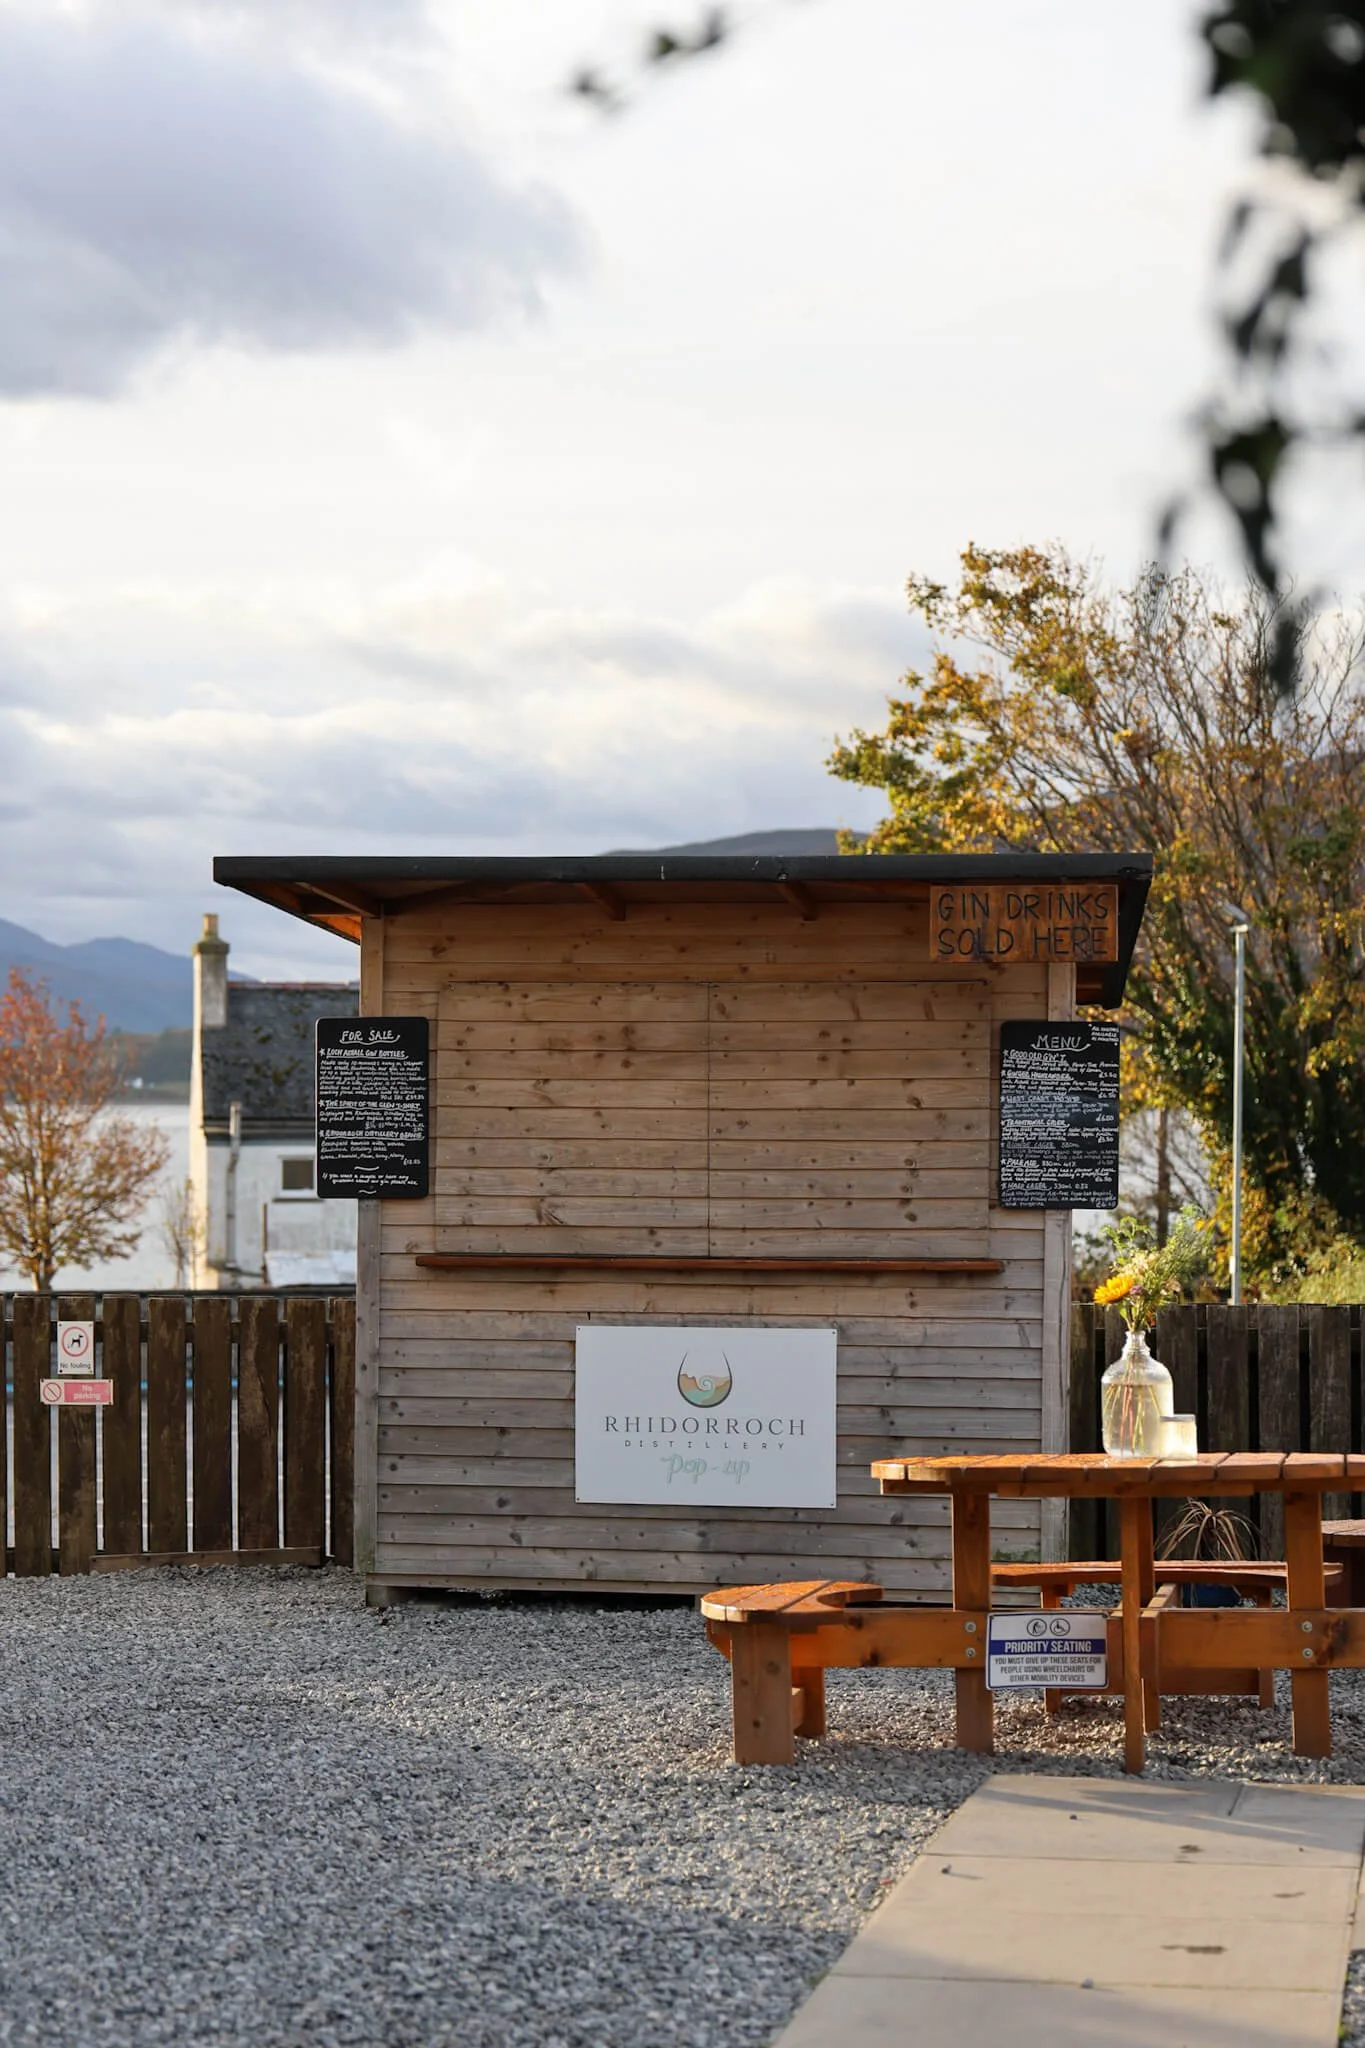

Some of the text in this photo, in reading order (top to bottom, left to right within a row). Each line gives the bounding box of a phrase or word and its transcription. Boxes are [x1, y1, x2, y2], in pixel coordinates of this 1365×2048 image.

[938, 892, 1108, 922] GIN DRINKS
[937, 927, 1108, 956] SOLD HERE
[342, 1030, 394, 1041] FOR SALE
[1037, 1035, 1081, 1049] MENU
[604, 1416, 806, 1436] RHIDORROCH
[625, 1440, 784, 1449] DISTILLERY
[1005, 1641, 1092, 1652] PRIORITY SEATING
[1069, 1656, 1088, 1664] SEATS
[1090, 1656, 1101, 1664] FOR
